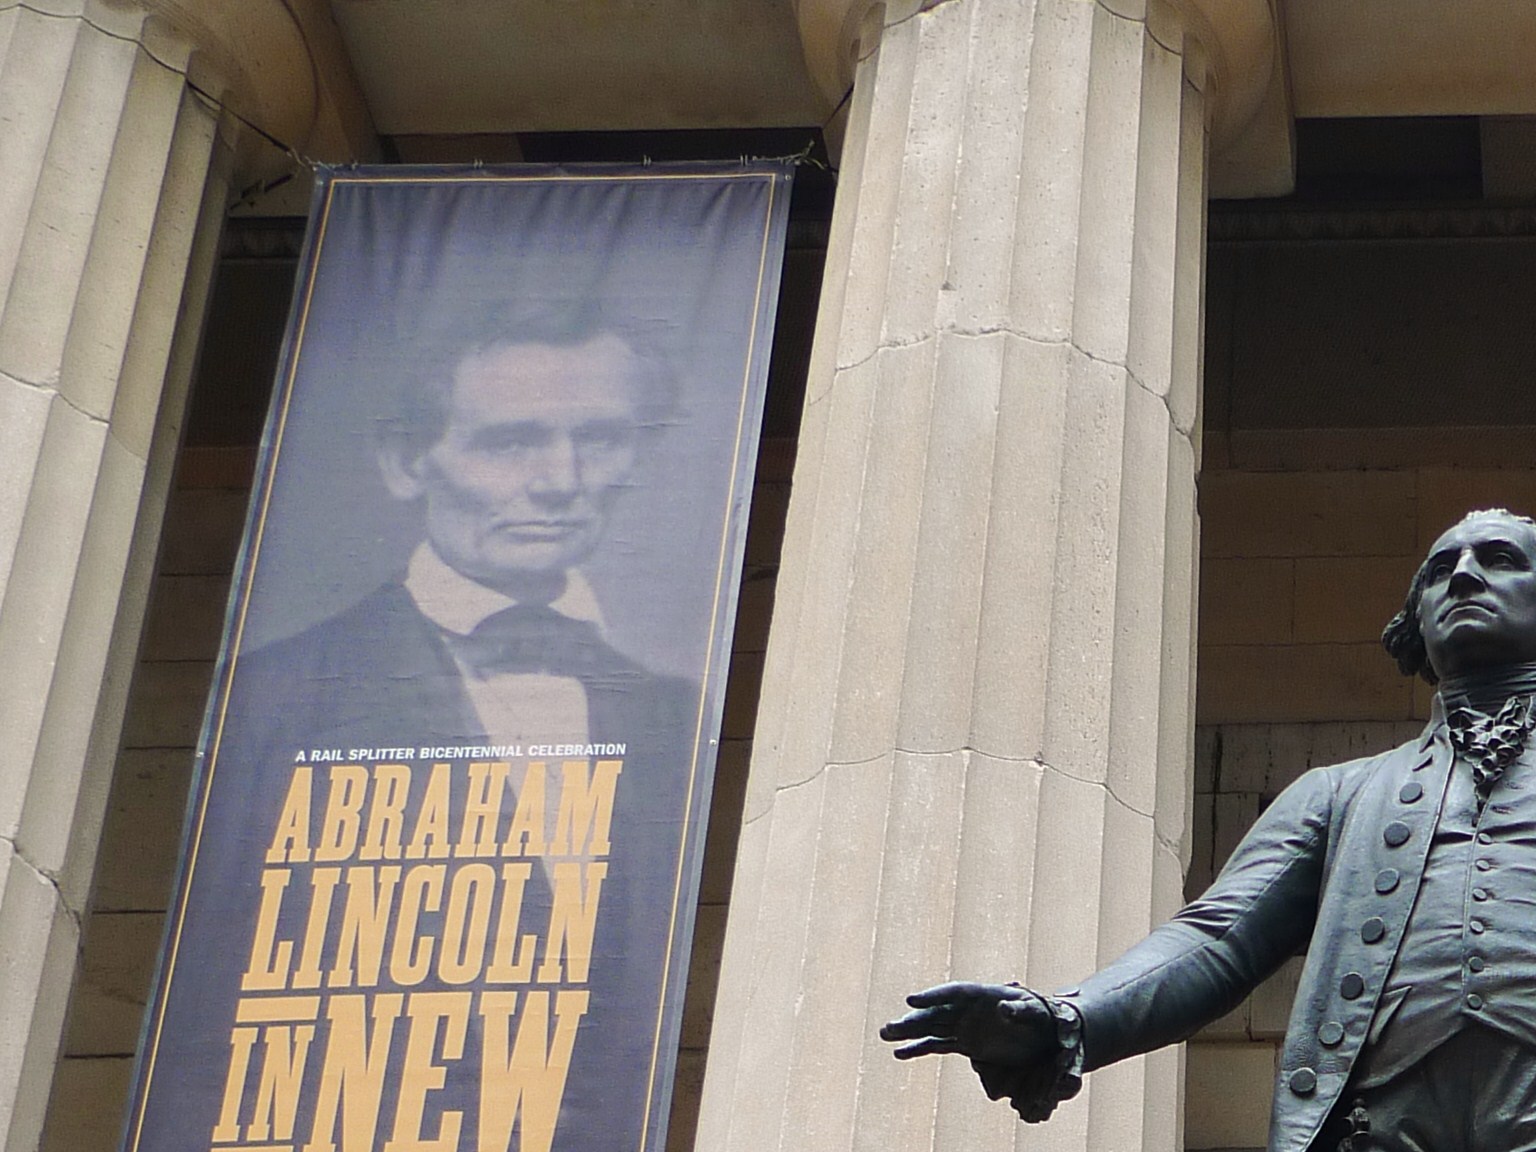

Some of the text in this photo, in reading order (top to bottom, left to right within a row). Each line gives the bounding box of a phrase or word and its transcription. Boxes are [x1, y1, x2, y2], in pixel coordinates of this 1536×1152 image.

[295, 743, 626, 762] A RAIL SPLITTER BICENTENNIAL CELEBRATION
[264, 760, 623, 864] ABRAHAM
[240, 861, 607, 991] LINCOLN
[211, 1024, 314, 1143] IN
